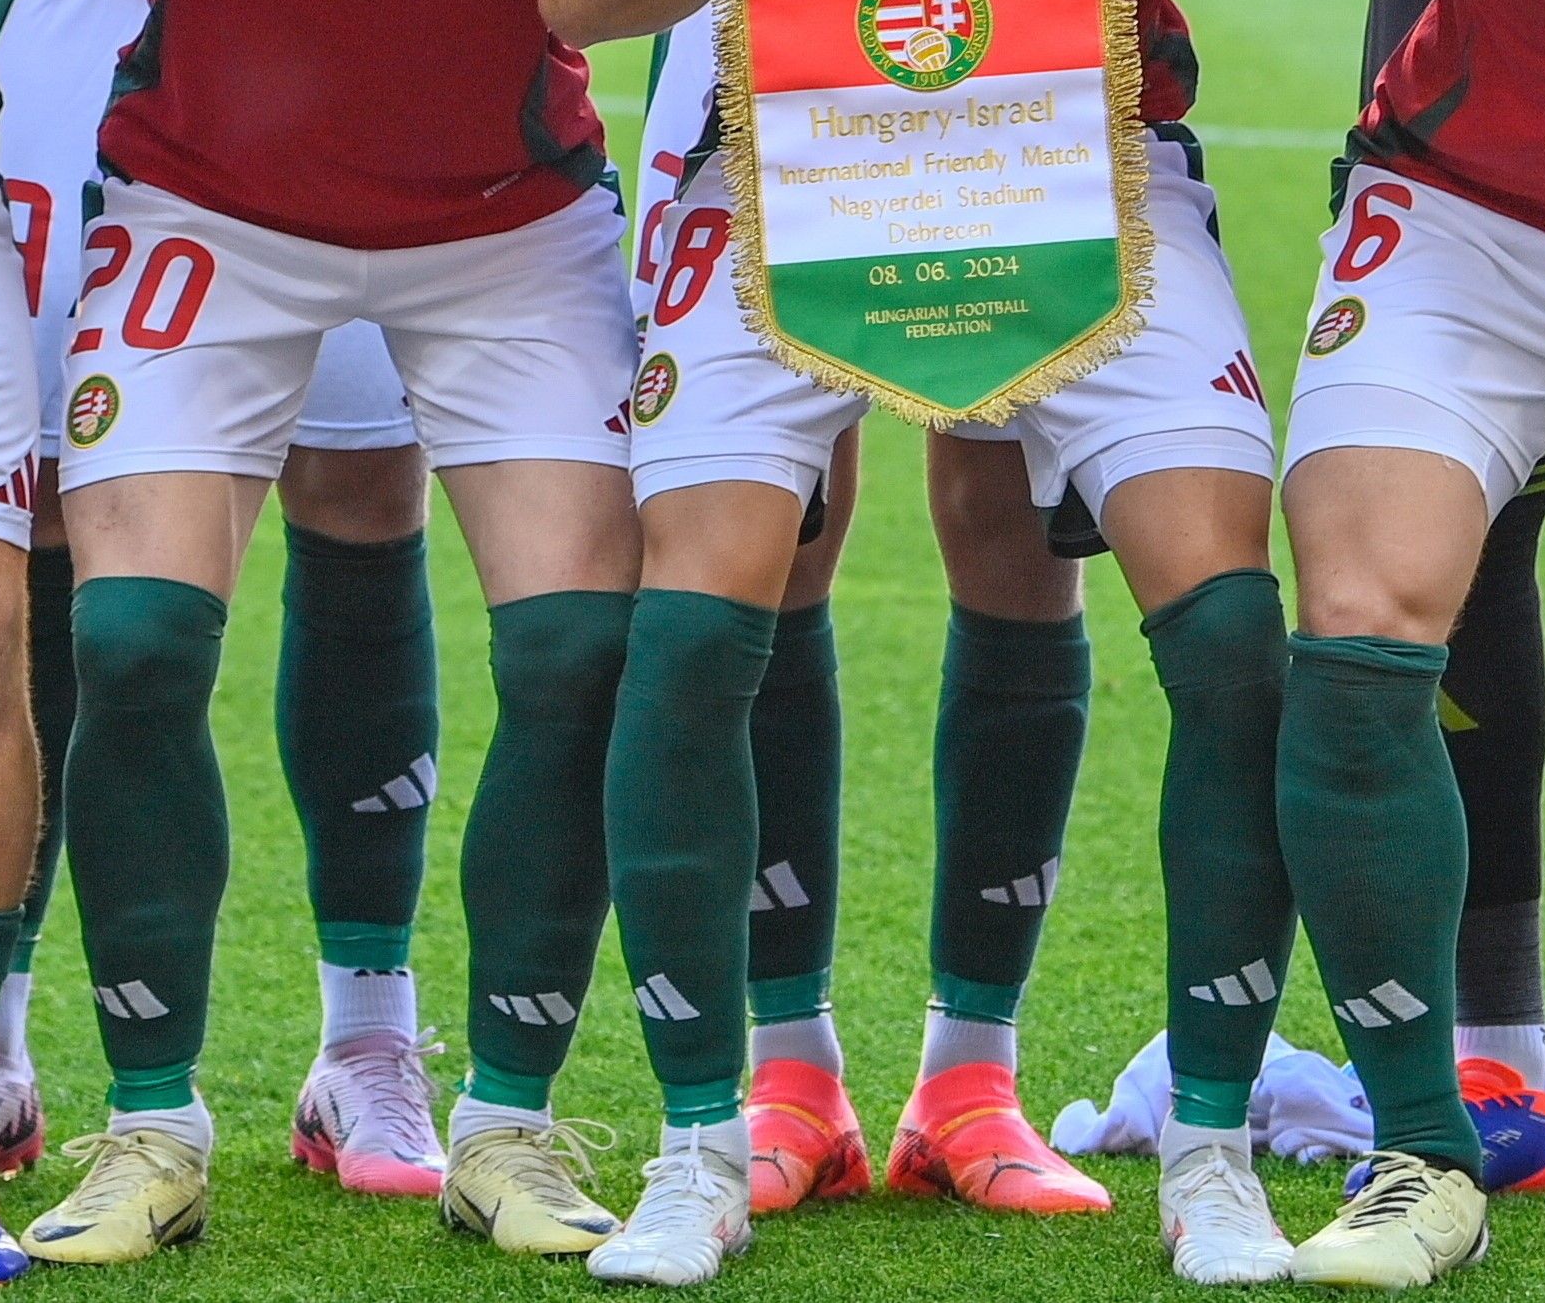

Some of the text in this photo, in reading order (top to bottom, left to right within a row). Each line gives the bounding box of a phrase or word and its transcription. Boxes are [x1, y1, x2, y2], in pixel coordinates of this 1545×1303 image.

[911, 70, 949, 87] 1901
[809, 90, 1055, 143] Hungary-Israel
[779, 142, 1090, 185] International Friendly Match
[829, 183, 1046, 221] Nagyerdei Stadium
[887, 221, 993, 244] Debrecen
[1333, 182, 1413, 283] 6
[868, 255, 1020, 286] 08. 06. 2024
[69, 224, 215, 356] 20
[864, 299, 1030, 325] HUNGARIAN FOOTBALL
[905, 319, 993, 339] FEDERATION
